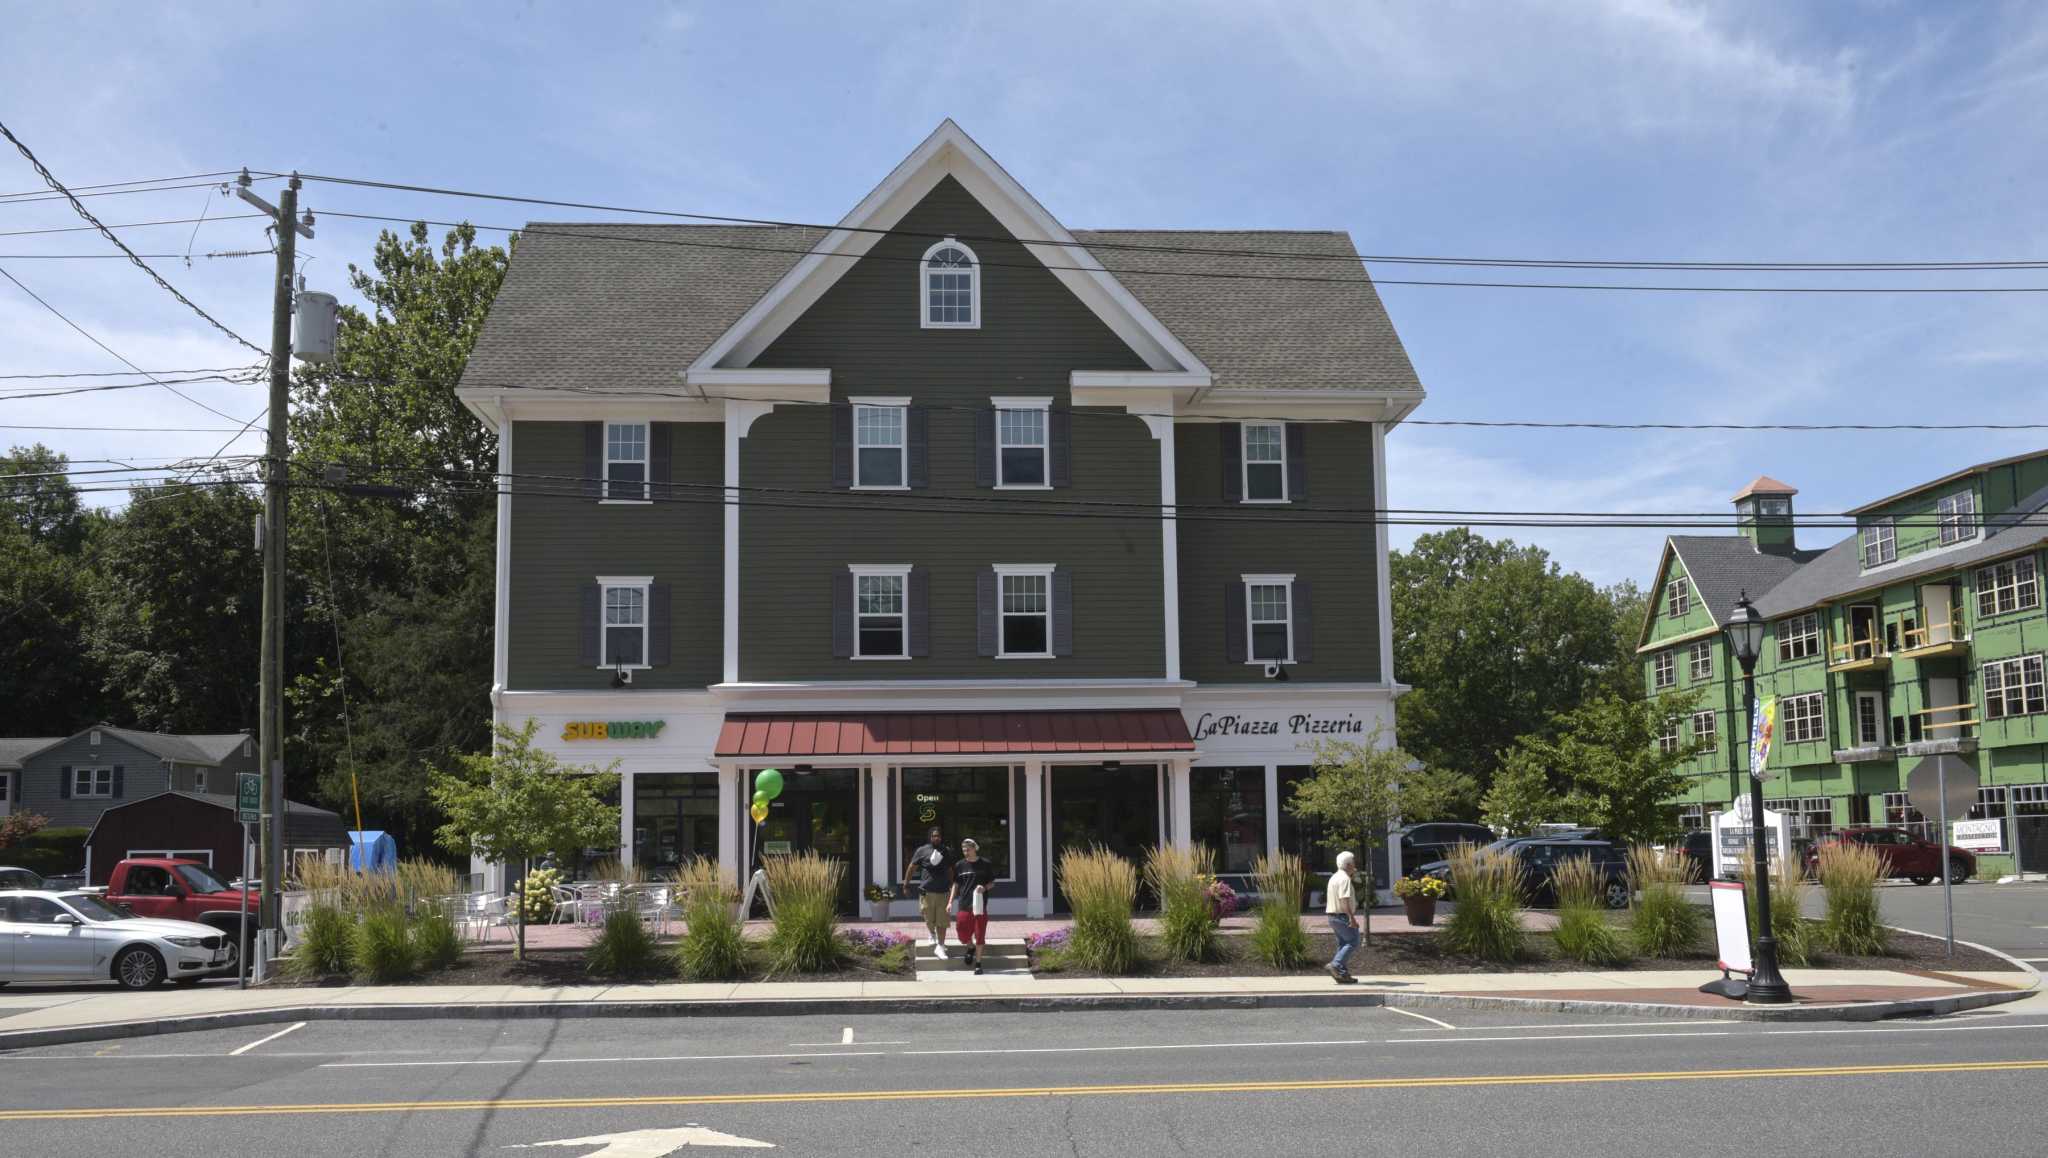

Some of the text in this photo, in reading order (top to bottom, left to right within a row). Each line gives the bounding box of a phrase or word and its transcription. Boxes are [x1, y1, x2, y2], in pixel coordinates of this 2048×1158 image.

[560, 720, 666, 741] SUBWAY
[1288, 714, 1363, 734] Pizzeria
[916, 794, 939, 802] Open
